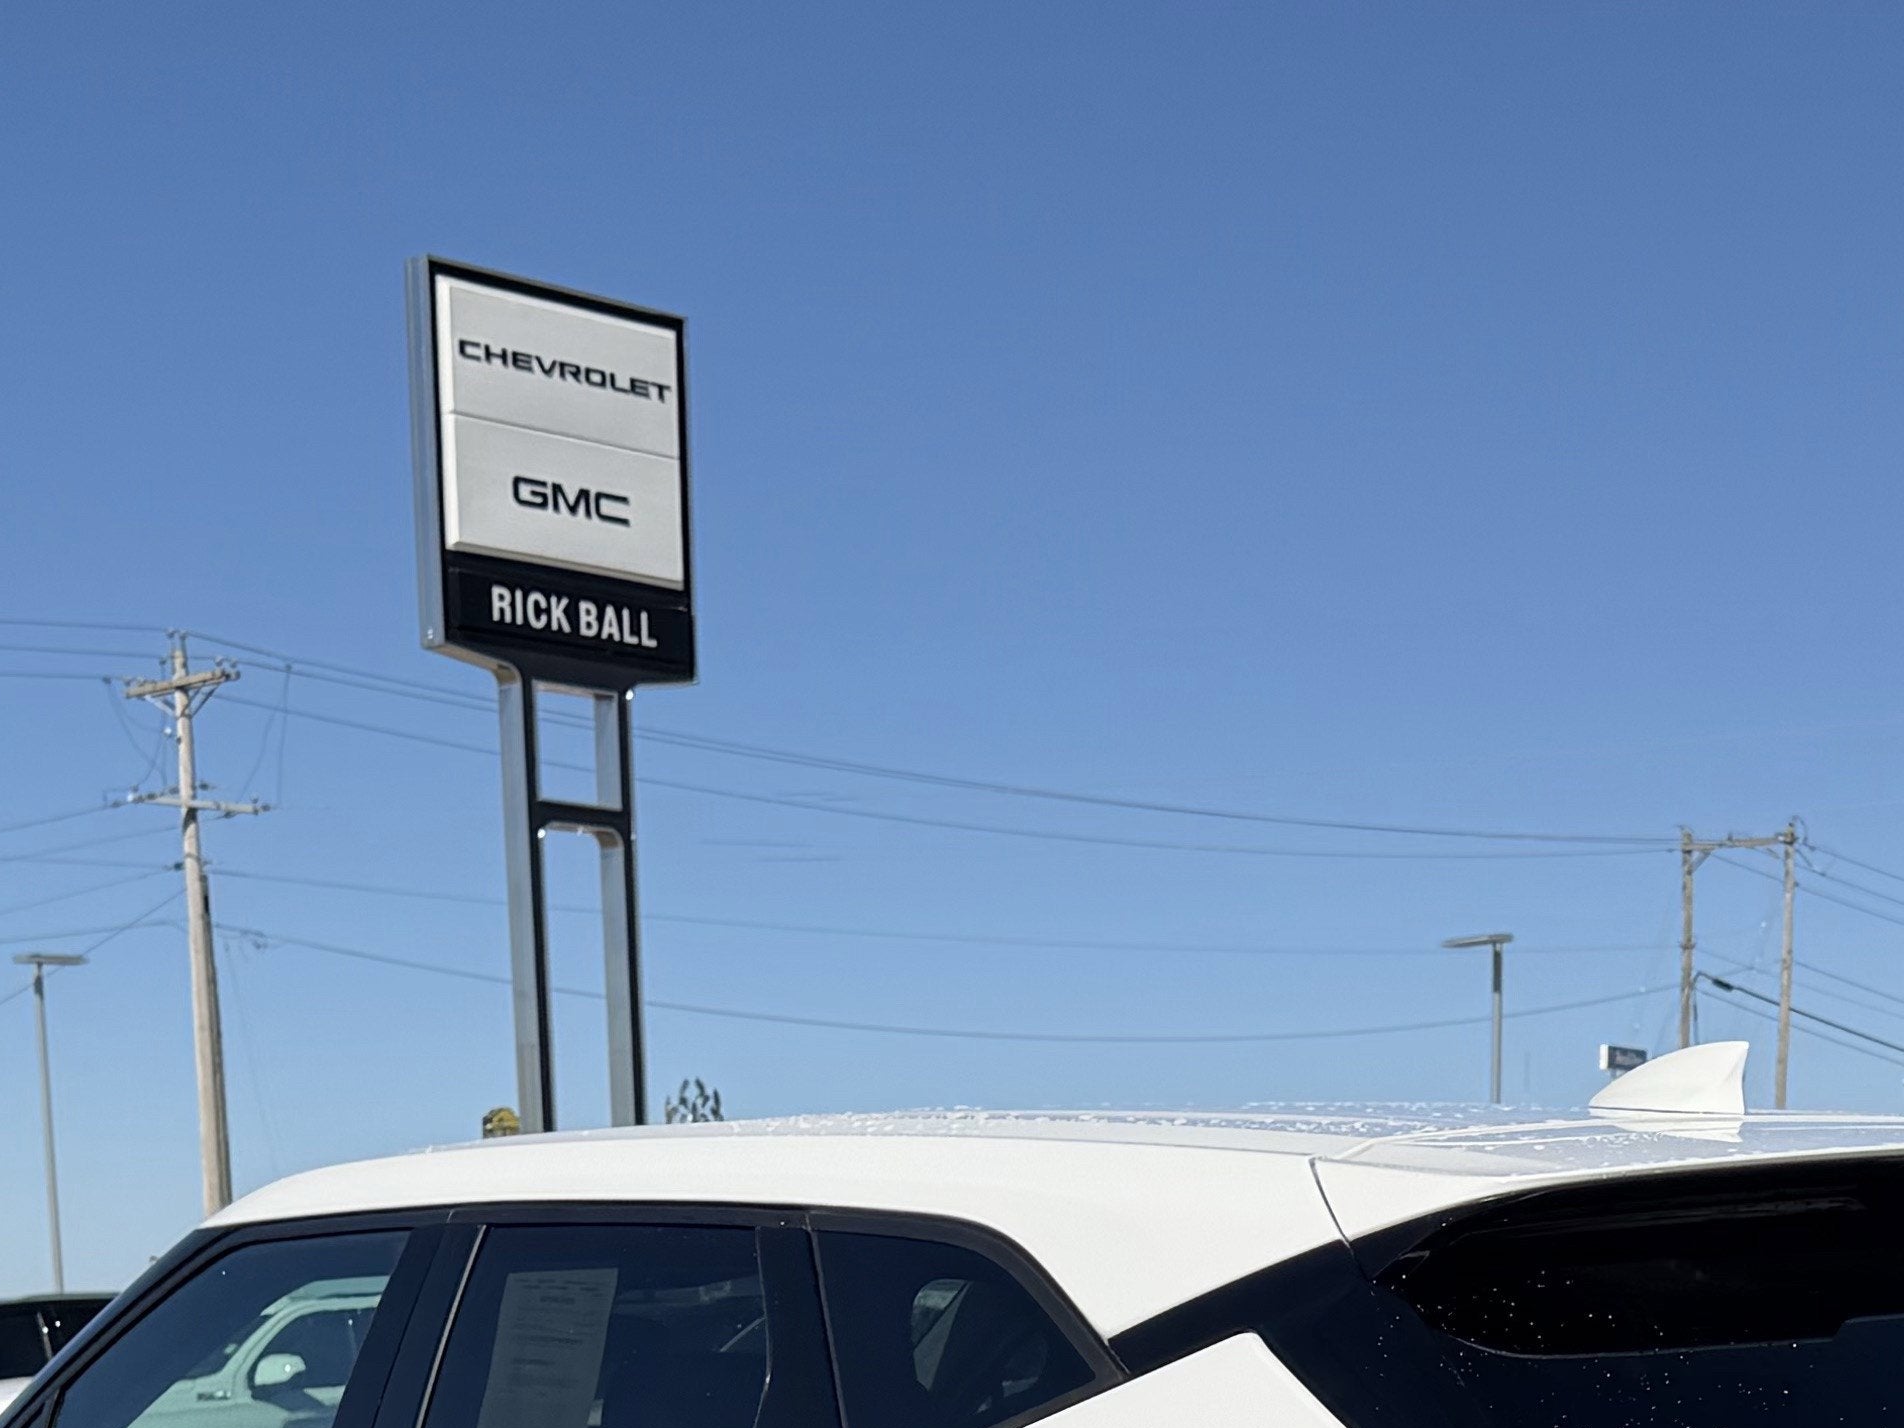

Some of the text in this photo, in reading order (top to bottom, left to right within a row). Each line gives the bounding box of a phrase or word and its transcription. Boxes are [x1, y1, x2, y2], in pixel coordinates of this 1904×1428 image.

[458, 339, 672, 405] CHEVROLET
[511, 474, 631, 528] GMC
[490, 584, 658, 650] RICK BALL
